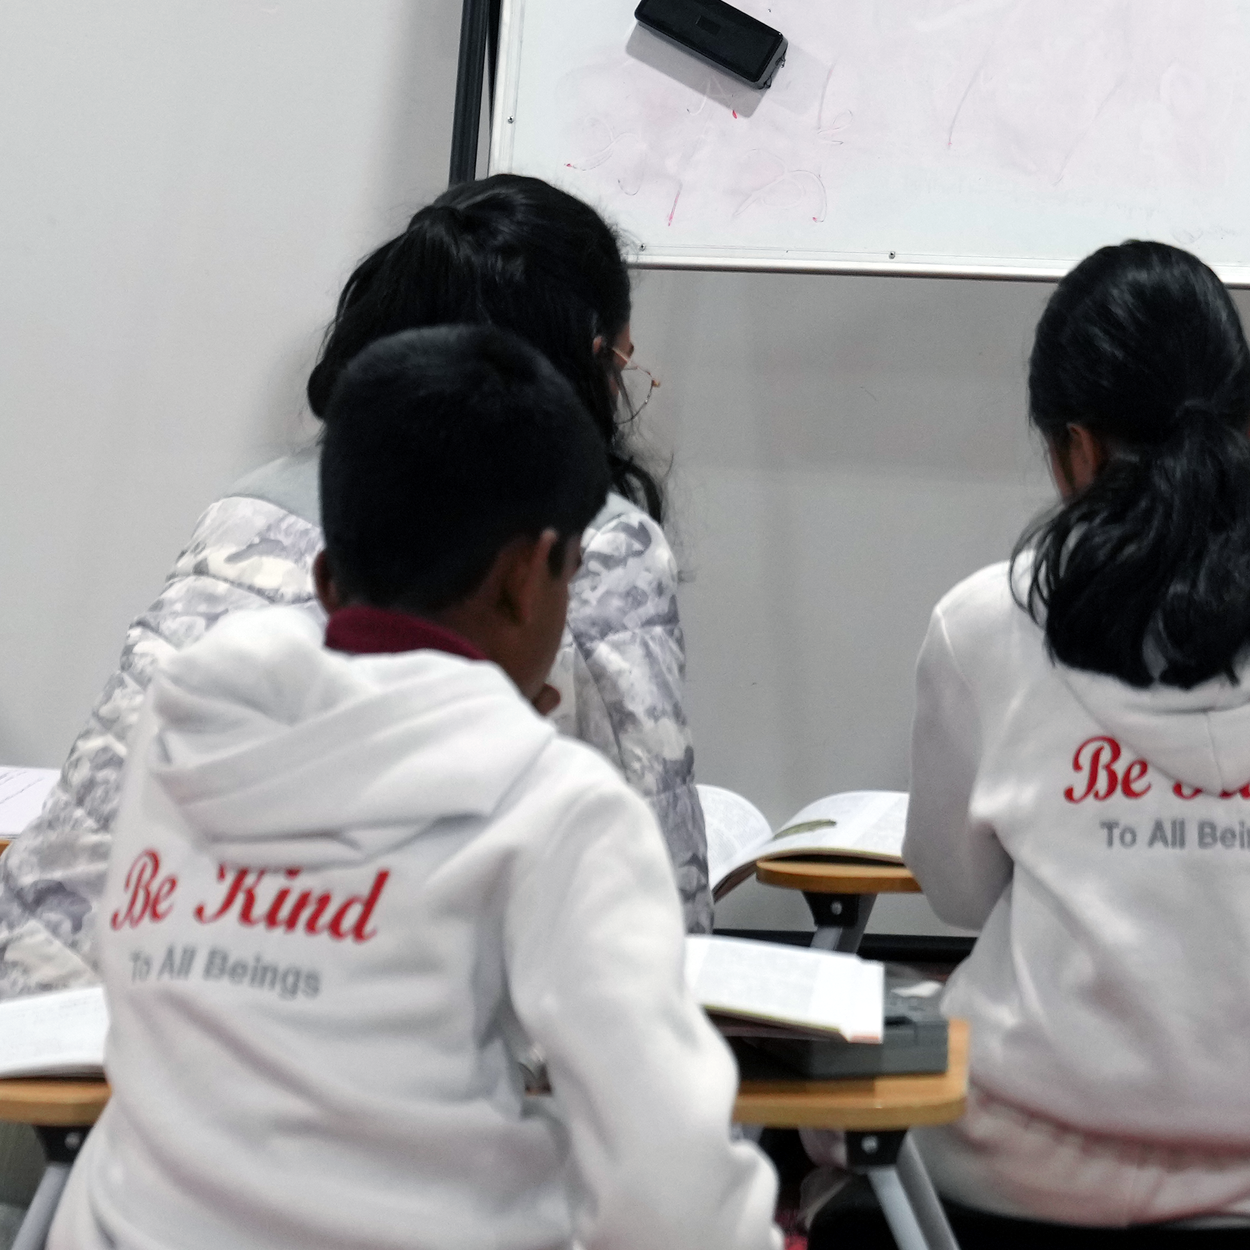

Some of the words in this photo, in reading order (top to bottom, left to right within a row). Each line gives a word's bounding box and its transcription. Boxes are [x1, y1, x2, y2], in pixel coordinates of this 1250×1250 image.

[1063, 734, 1152, 805] Be
[1100, 819, 1138, 849] To
[1147, 817, 1186, 849] All
[109, 847, 179, 932] Be
[193, 861, 391, 944] Kind
[156, 944, 197, 981] All
[201, 947, 322, 1001] Beings
